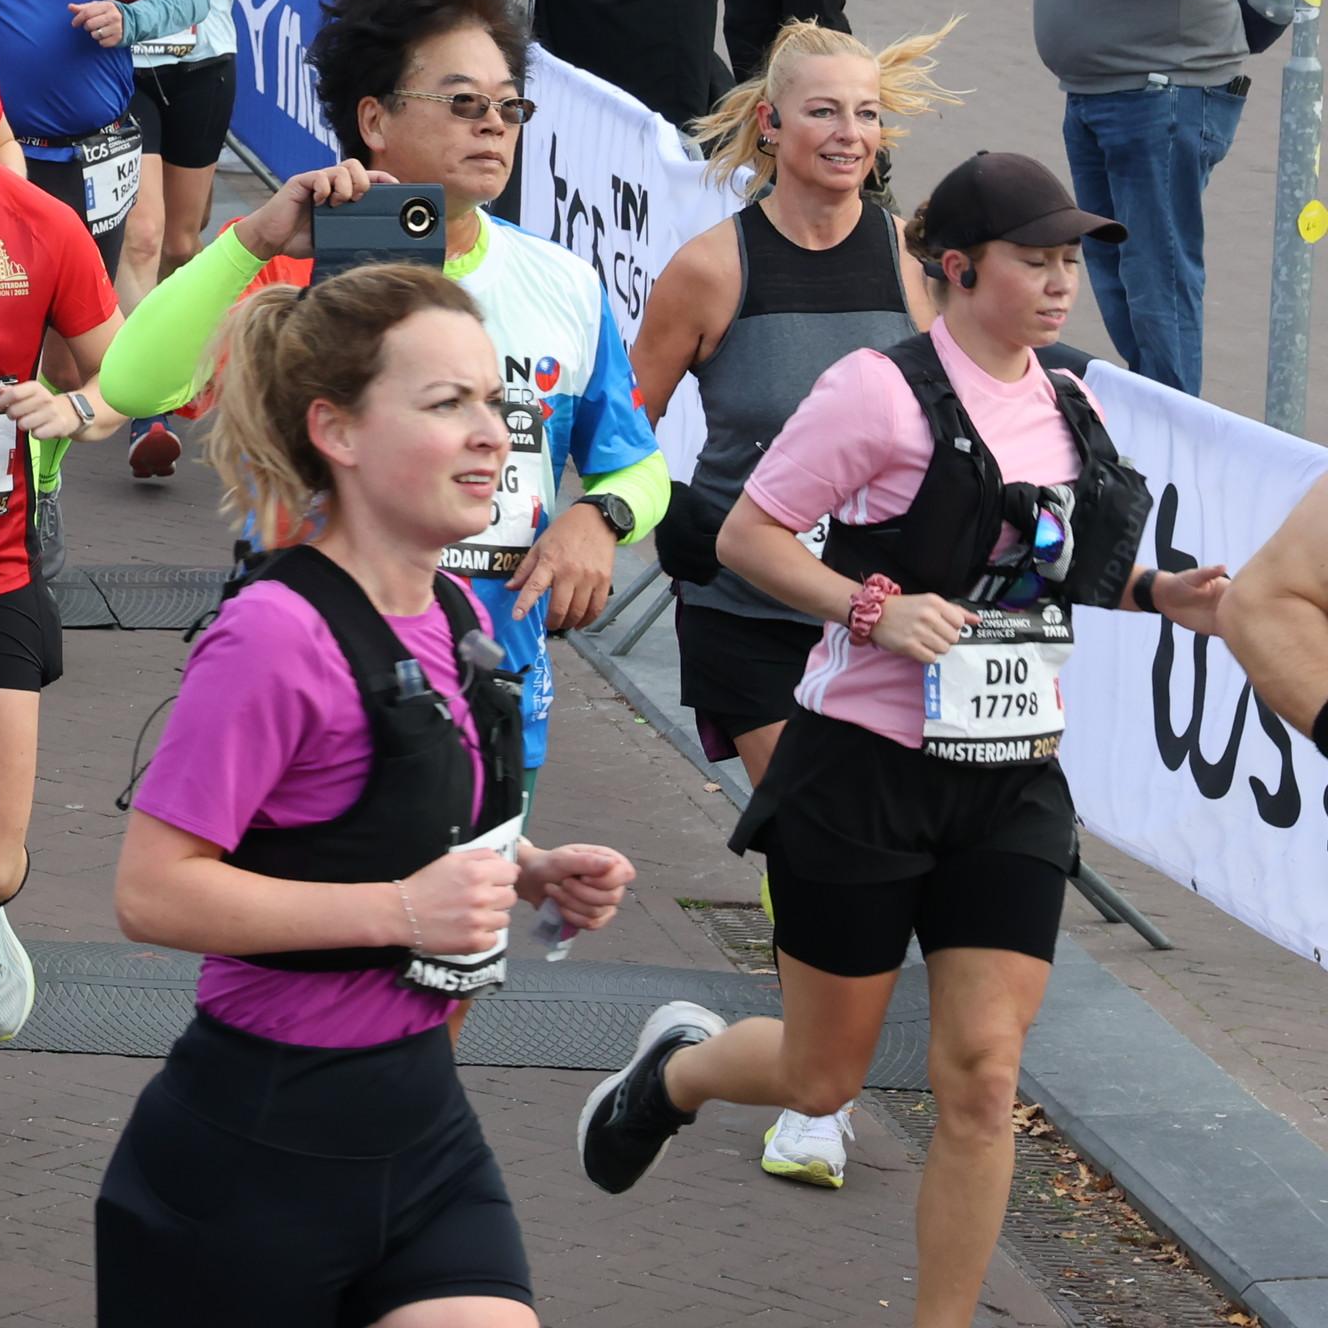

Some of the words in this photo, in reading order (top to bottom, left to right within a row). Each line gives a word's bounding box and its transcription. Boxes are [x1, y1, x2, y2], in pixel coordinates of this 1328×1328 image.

[83, 142, 109, 163] tcs
[14, 289, 29, 297] 2025
[975, 628, 1016, 639] SERVICES
[1042, 625, 1070, 638] TATA
[985, 657, 1029, 685] DIO
[970, 691, 1039, 719] 17798
[926, 738, 1031, 764] AMSTERDAM
